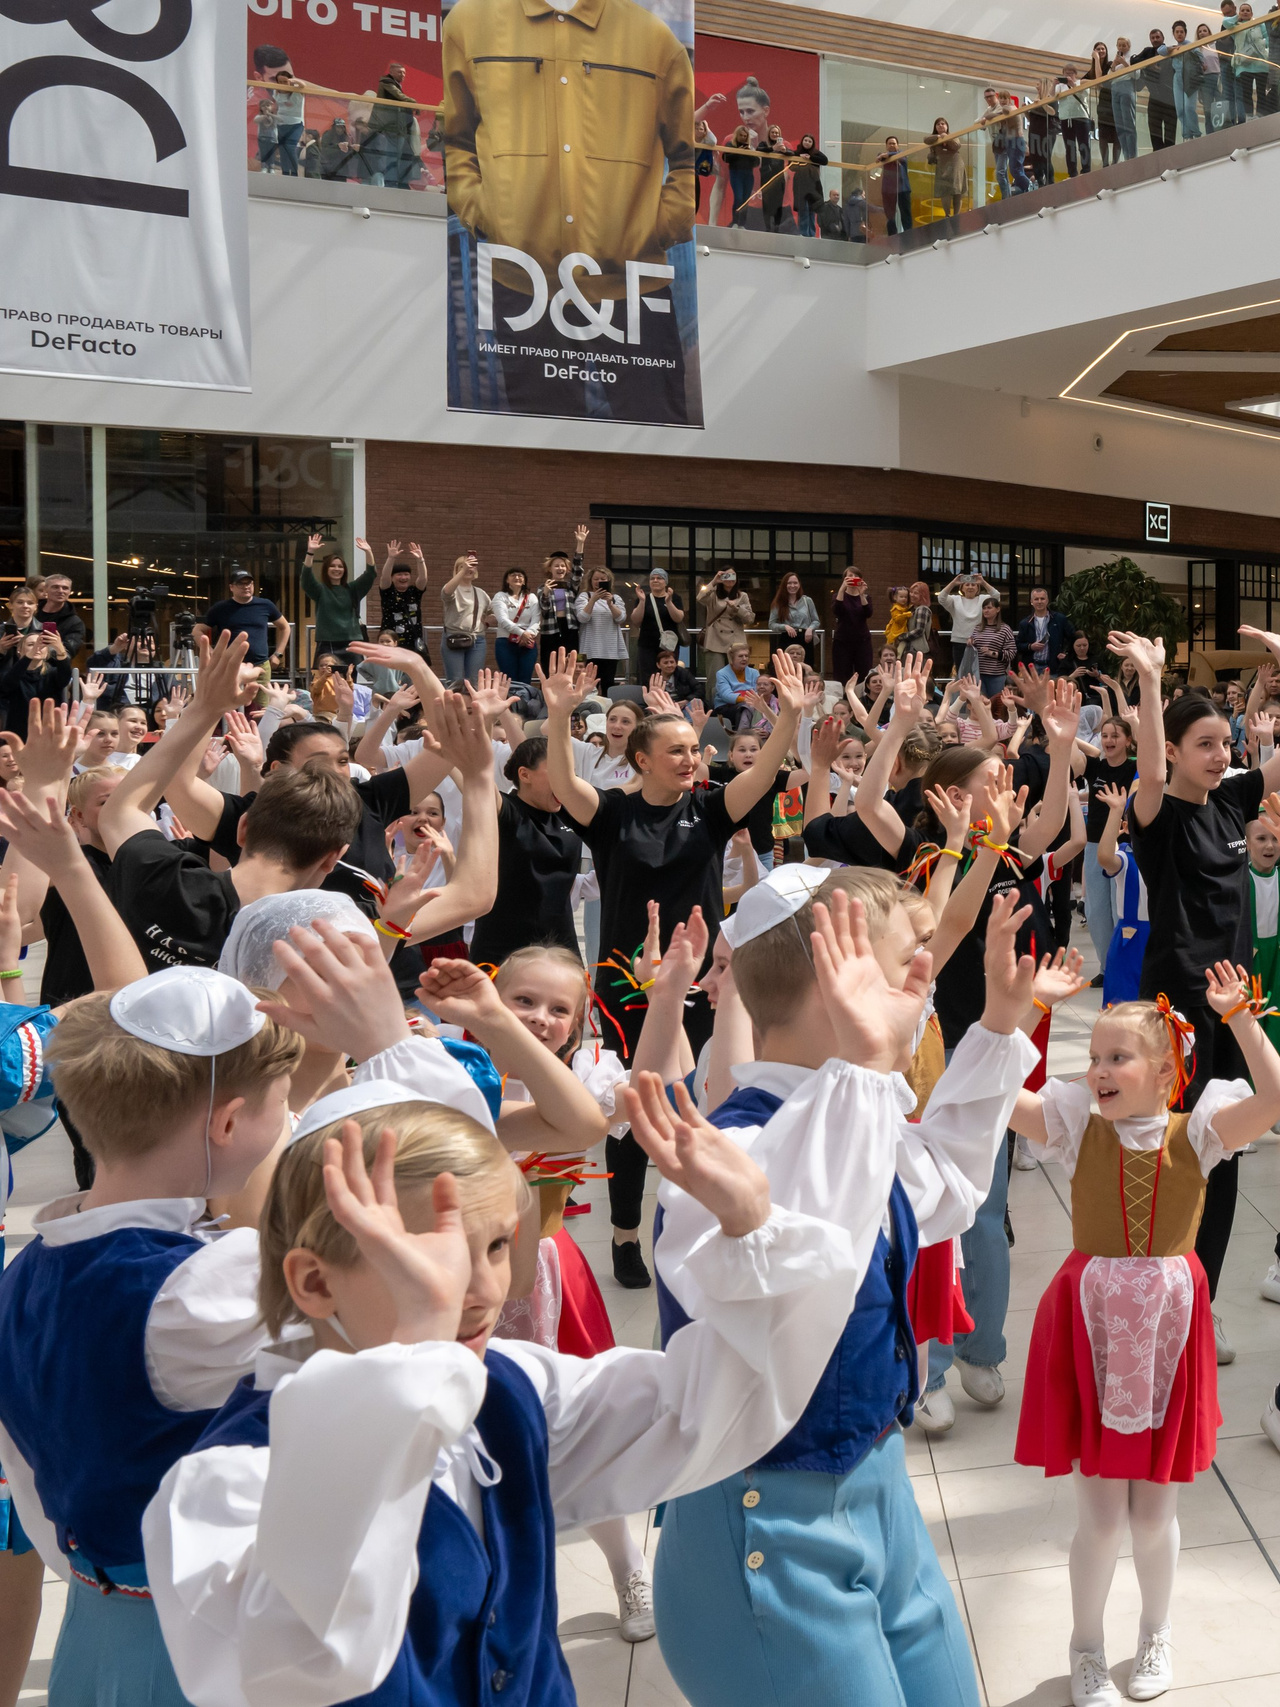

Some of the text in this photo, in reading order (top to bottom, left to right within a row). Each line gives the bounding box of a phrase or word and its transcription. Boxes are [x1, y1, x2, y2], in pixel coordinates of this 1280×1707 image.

[353, 2, 443, 43] ТЕН
[477, 242, 675, 345] D&F
[57, 314, 155, 333] ПРОДАВАТЬ
[159, 323, 223, 340] ТОВАРЫ
[31, 330, 137, 356] DeFacto
[479, 342, 676, 369] ИМЕЕТ ПРАВО ПРОДАВАТЬ ТОВАРЫ
[544, 363, 617, 384] DeFacto
